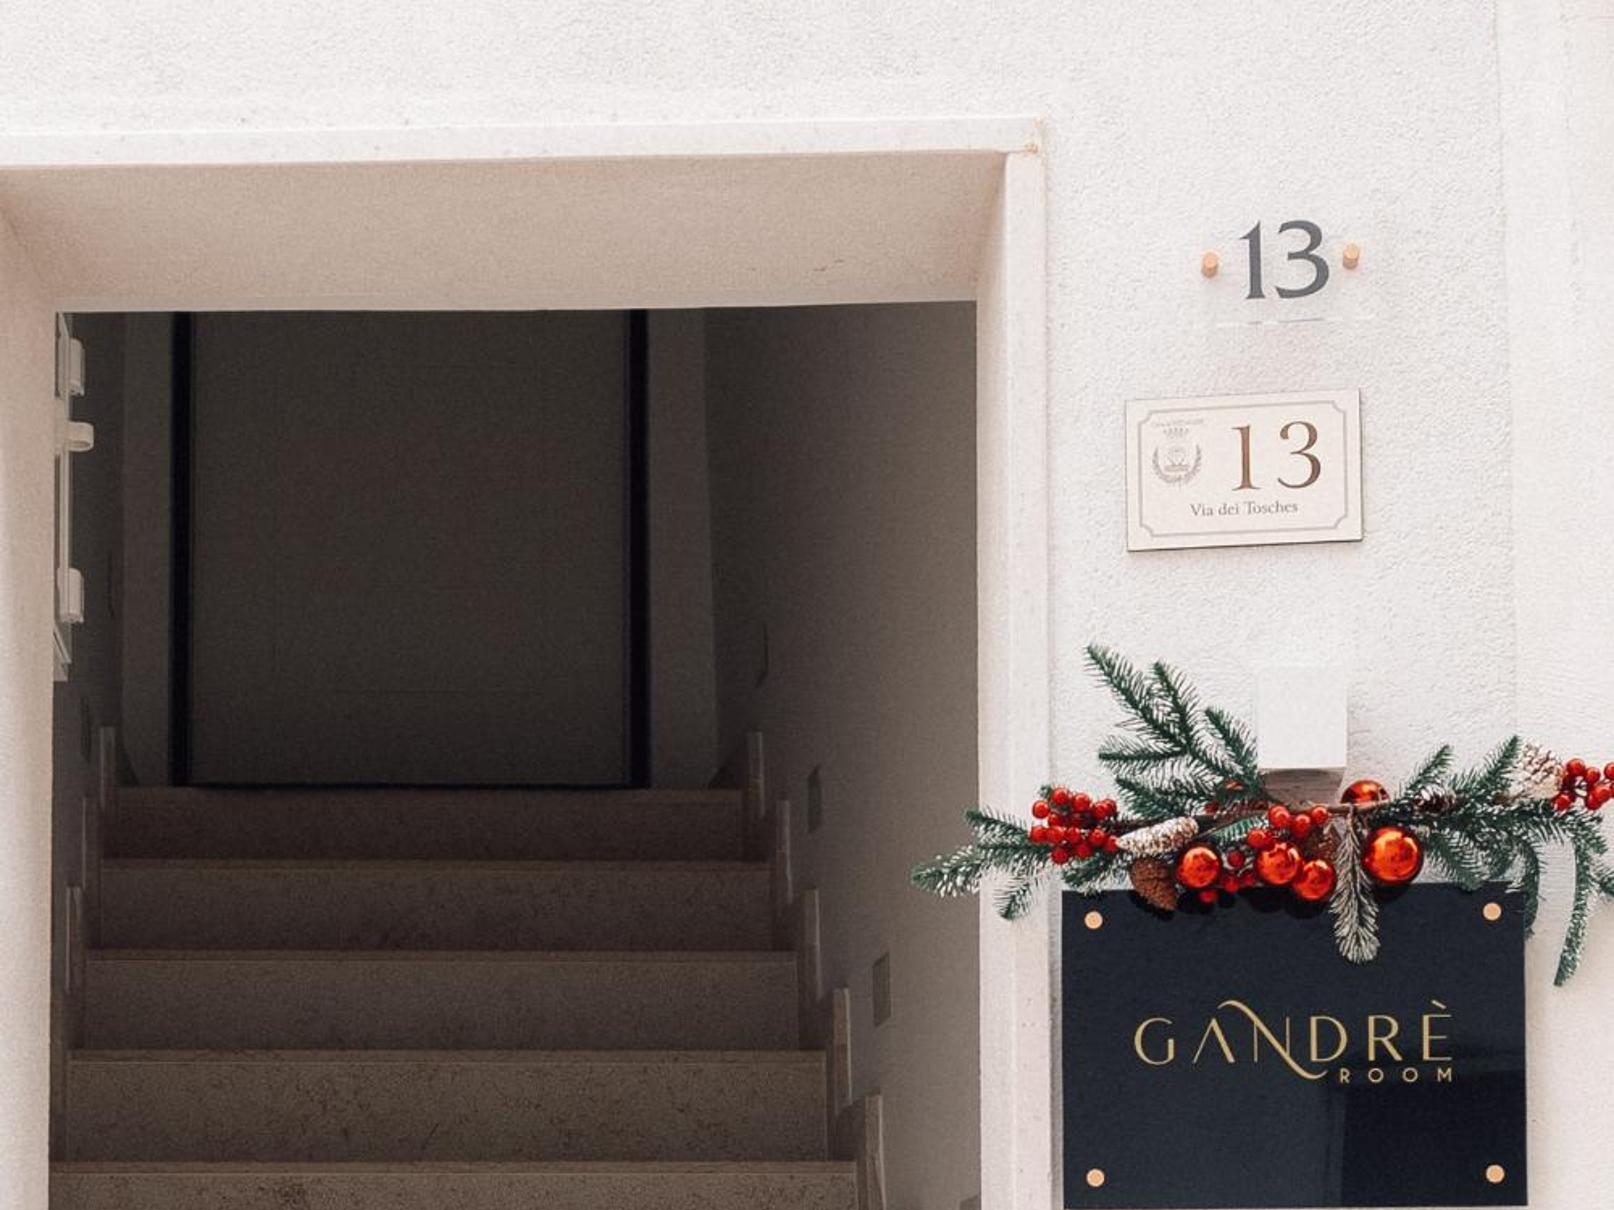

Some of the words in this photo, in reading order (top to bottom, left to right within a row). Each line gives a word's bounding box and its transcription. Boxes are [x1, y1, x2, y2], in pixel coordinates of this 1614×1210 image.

[1239, 219, 1330, 300] 13
[1231, 420, 1323, 491] 13
[1189, 503, 1213, 516] Via
[1218, 502, 1239, 515] dei
[1243, 500, 1299, 515] Tosches
[1132, 999, 1453, 1081] GANDRÈ
[1340, 1067, 1453, 1084] ROOM
